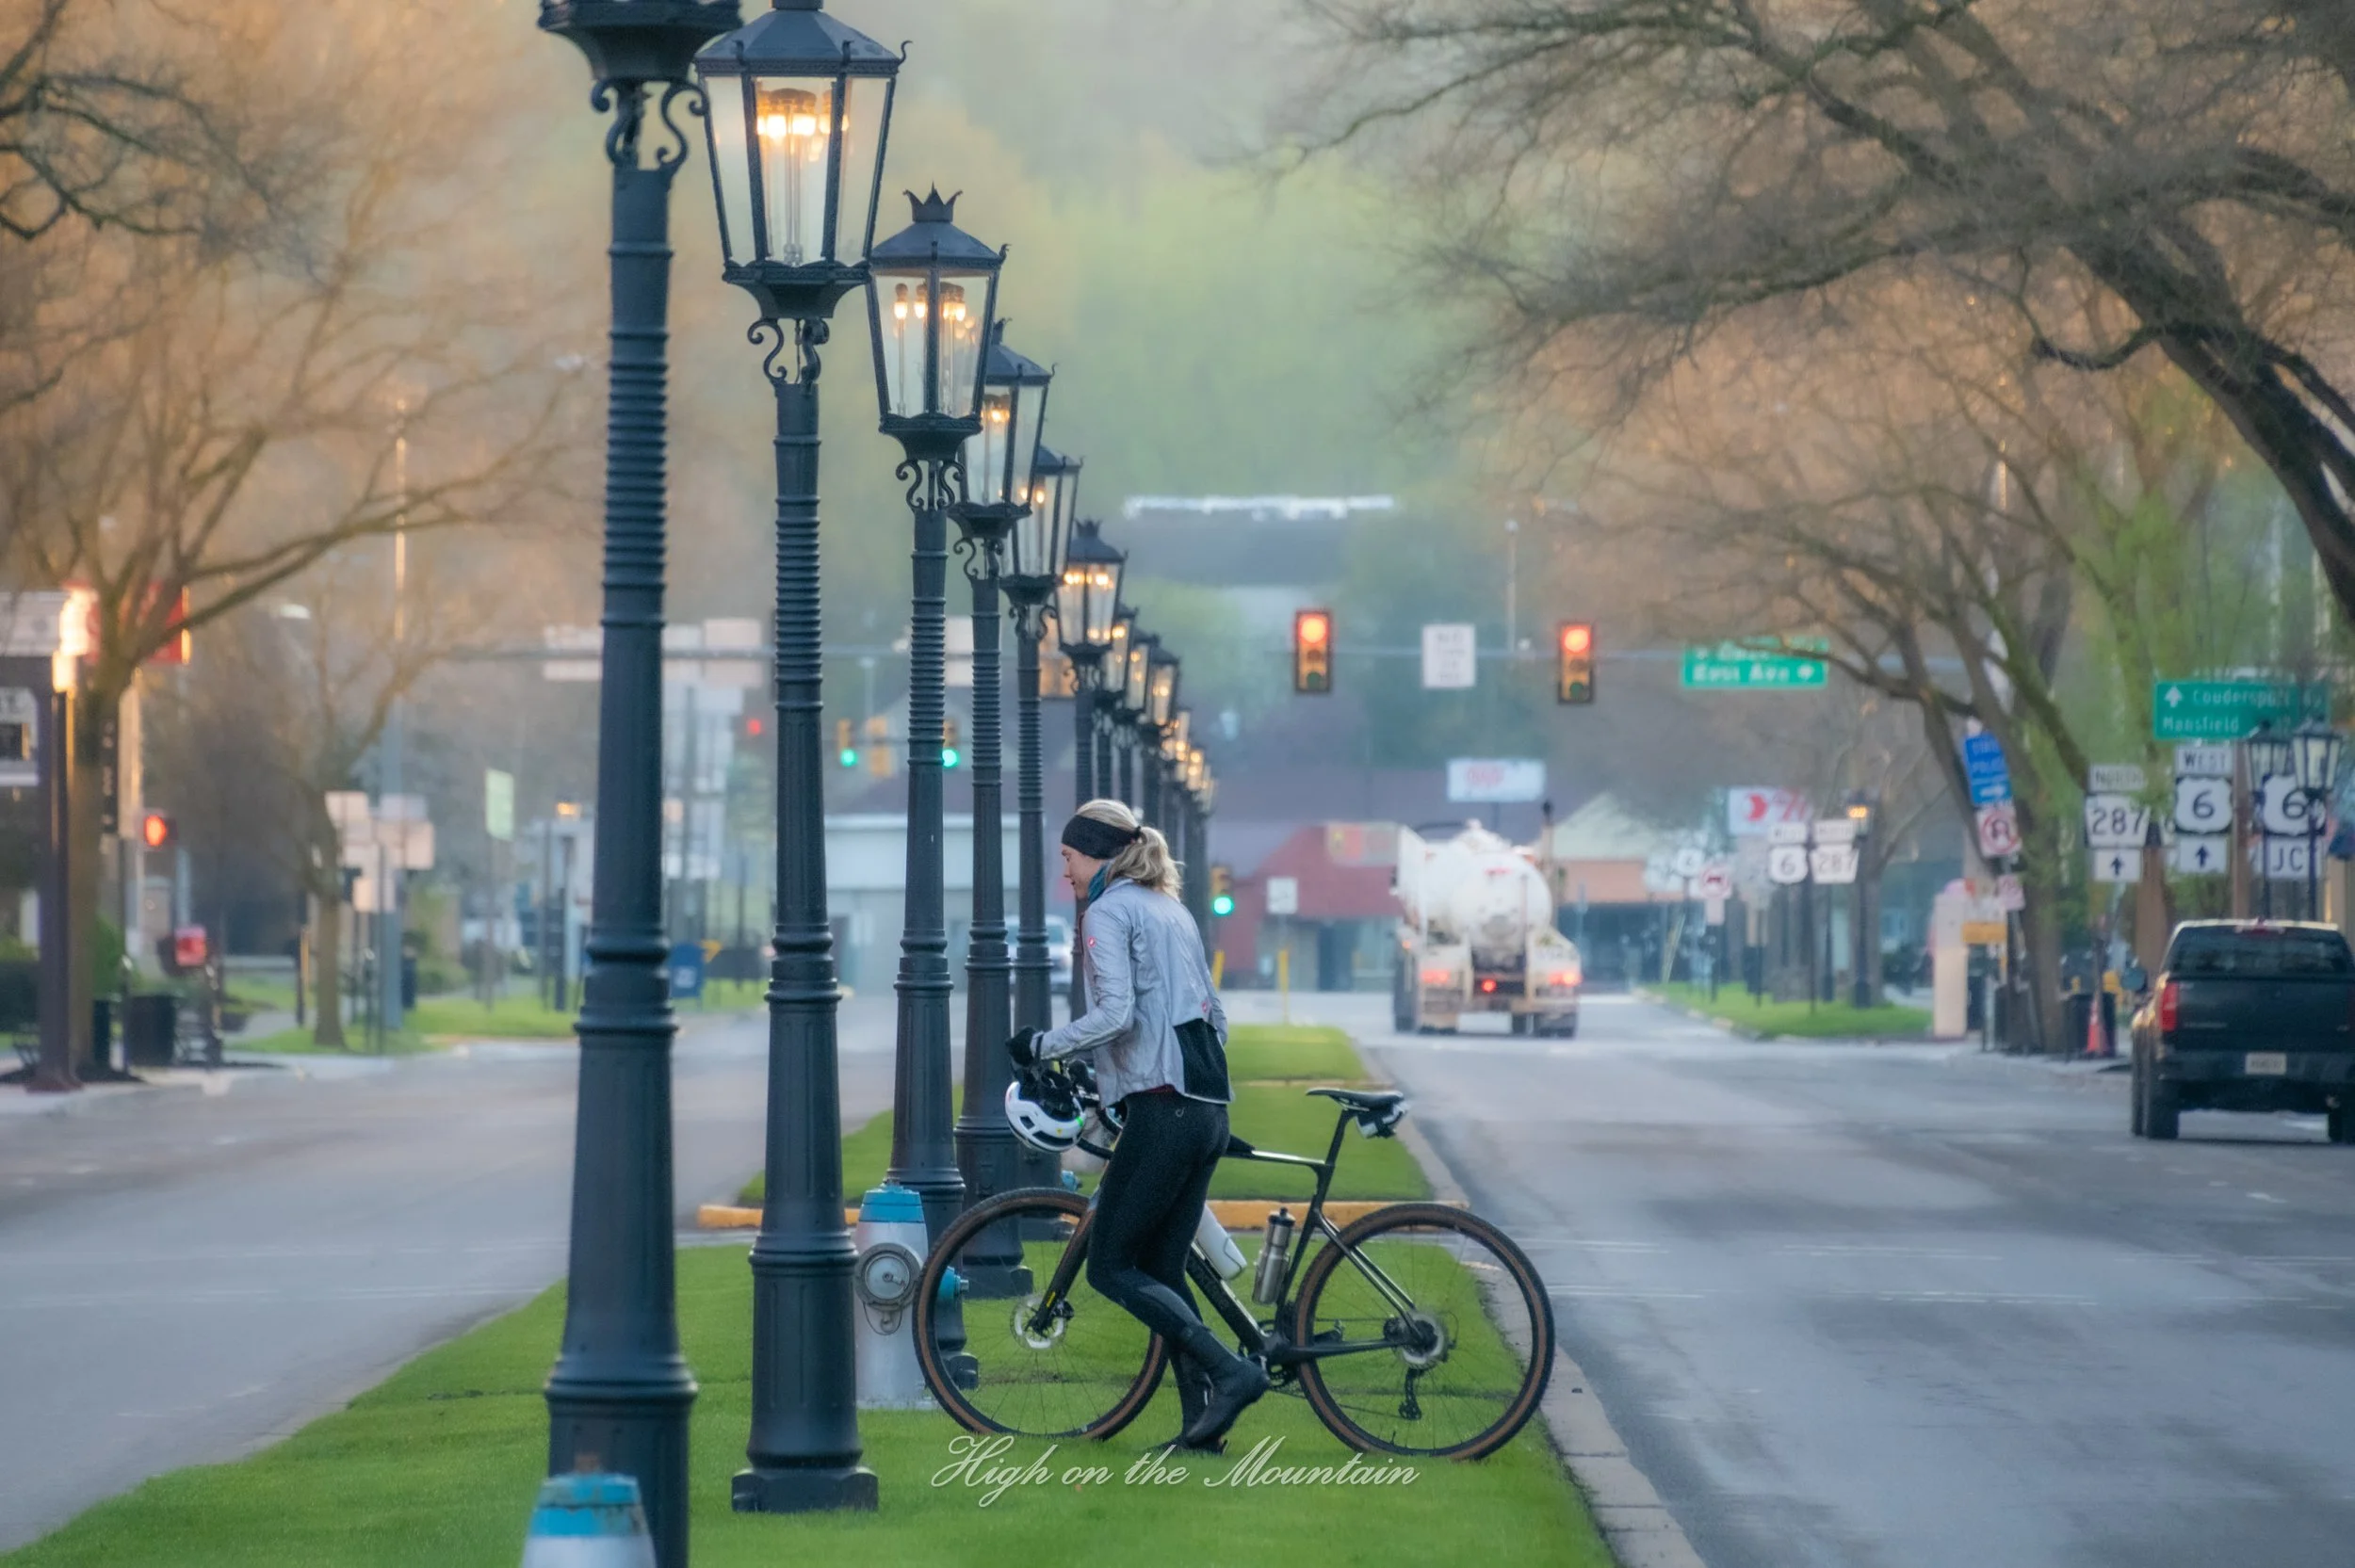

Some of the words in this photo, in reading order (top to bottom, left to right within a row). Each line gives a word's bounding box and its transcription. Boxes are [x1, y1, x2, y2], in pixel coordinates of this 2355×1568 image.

[2162, 715, 2240, 733] Mansfield
[2192, 788, 2215, 819] 6
[2282, 789, 2308, 819] 6
[2091, 806, 2144, 836] 287
[1779, 851, 1796, 875] 6
[1817, 851, 1858, 873] 287
[2272, 846, 2313, 872] JC
